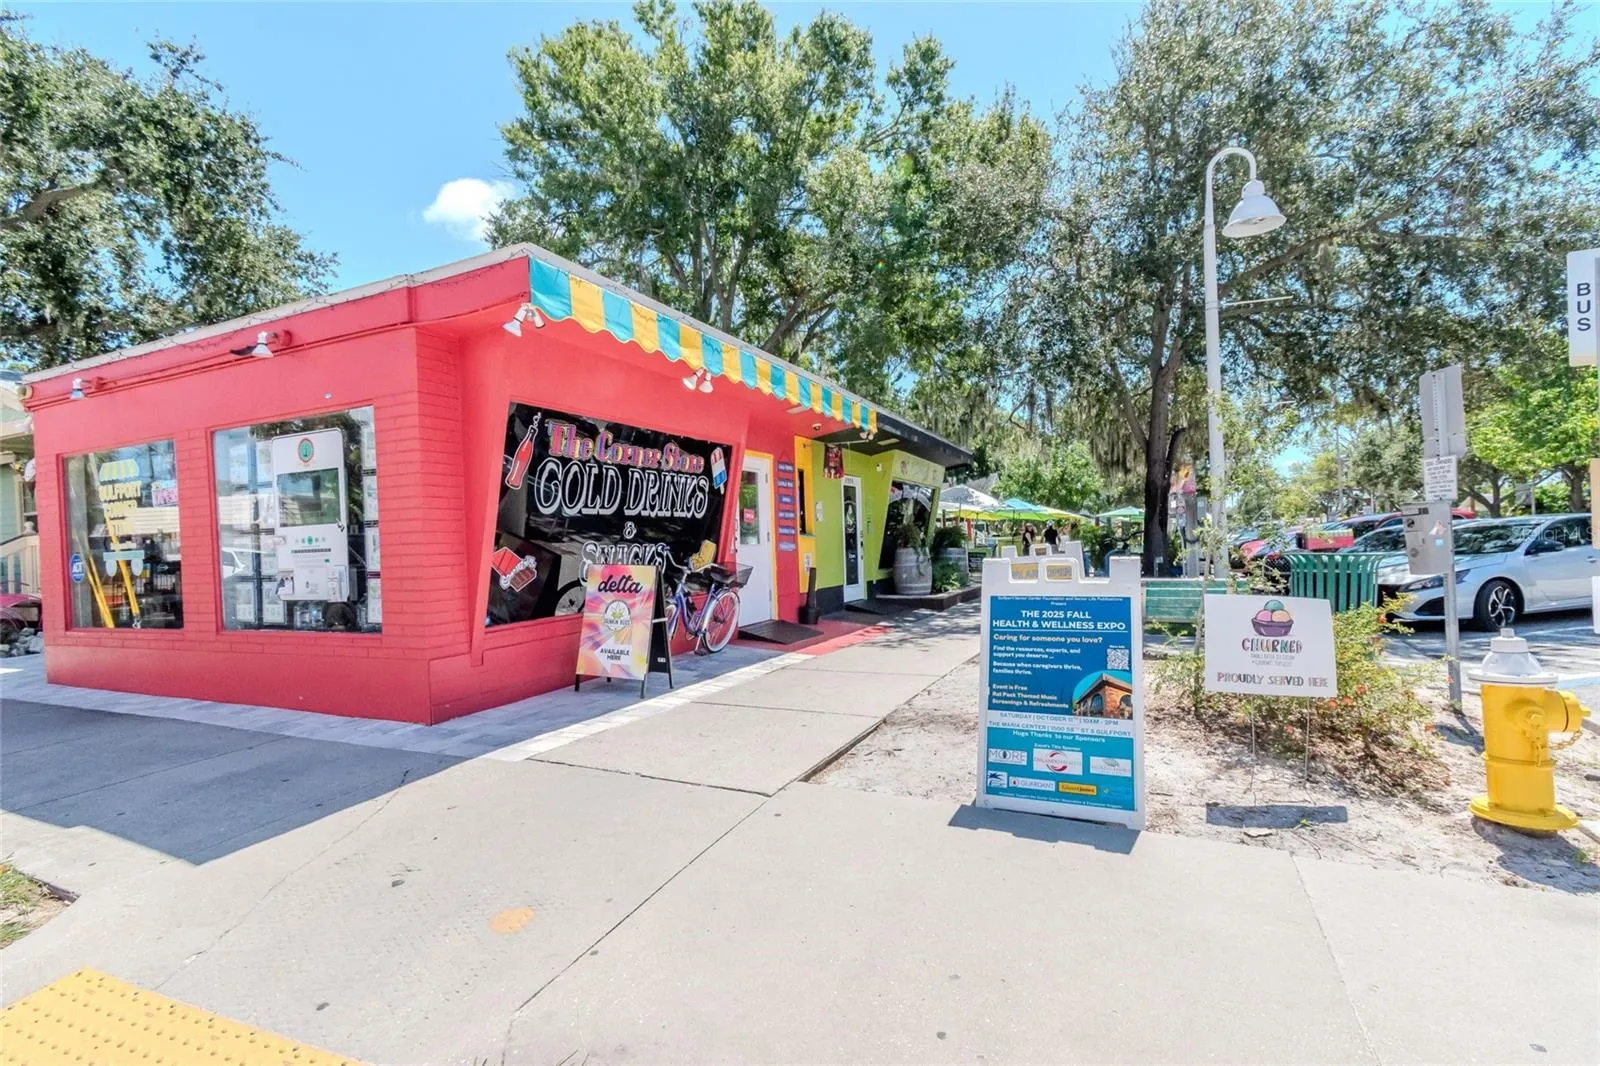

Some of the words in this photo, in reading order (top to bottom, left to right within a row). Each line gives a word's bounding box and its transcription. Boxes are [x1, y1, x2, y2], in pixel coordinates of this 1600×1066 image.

[1577, 282, 1592, 332] BUS
[545, 418, 594, 459] The
[593, 430, 662, 469] Corner
[661, 441, 706, 474] Store
[624, 467, 710, 518] DRINKS
[622, 521, 638, 539] &
[598, 574, 643, 594] delta
[1020, 610, 1040, 618] THE
[1042, 610, 1065, 619] 2025
[1067, 610, 1092, 619] FALL
[992, 619, 1030, 628] HEALTH
[1032, 620, 1039, 628] &
[1041, 620, 1095, 630] WELLNESS
[1097, 621, 1126, 630] EXPO
[993, 633, 1018, 642] Caring
[600, 647, 630, 656] AVAILABLE
[1241, 638, 1303, 654] CHURNED
[1217, 672, 1266, 685] PROUDLY
[1268, 675, 1305, 687] SERVED
[1308, 677, 1329, 688] HERE
[1036, 714, 1066, 722] OCTOBER
[1030, 731, 1052, 739] Thanks
[1075, 735, 1106, 743] Sponsors
